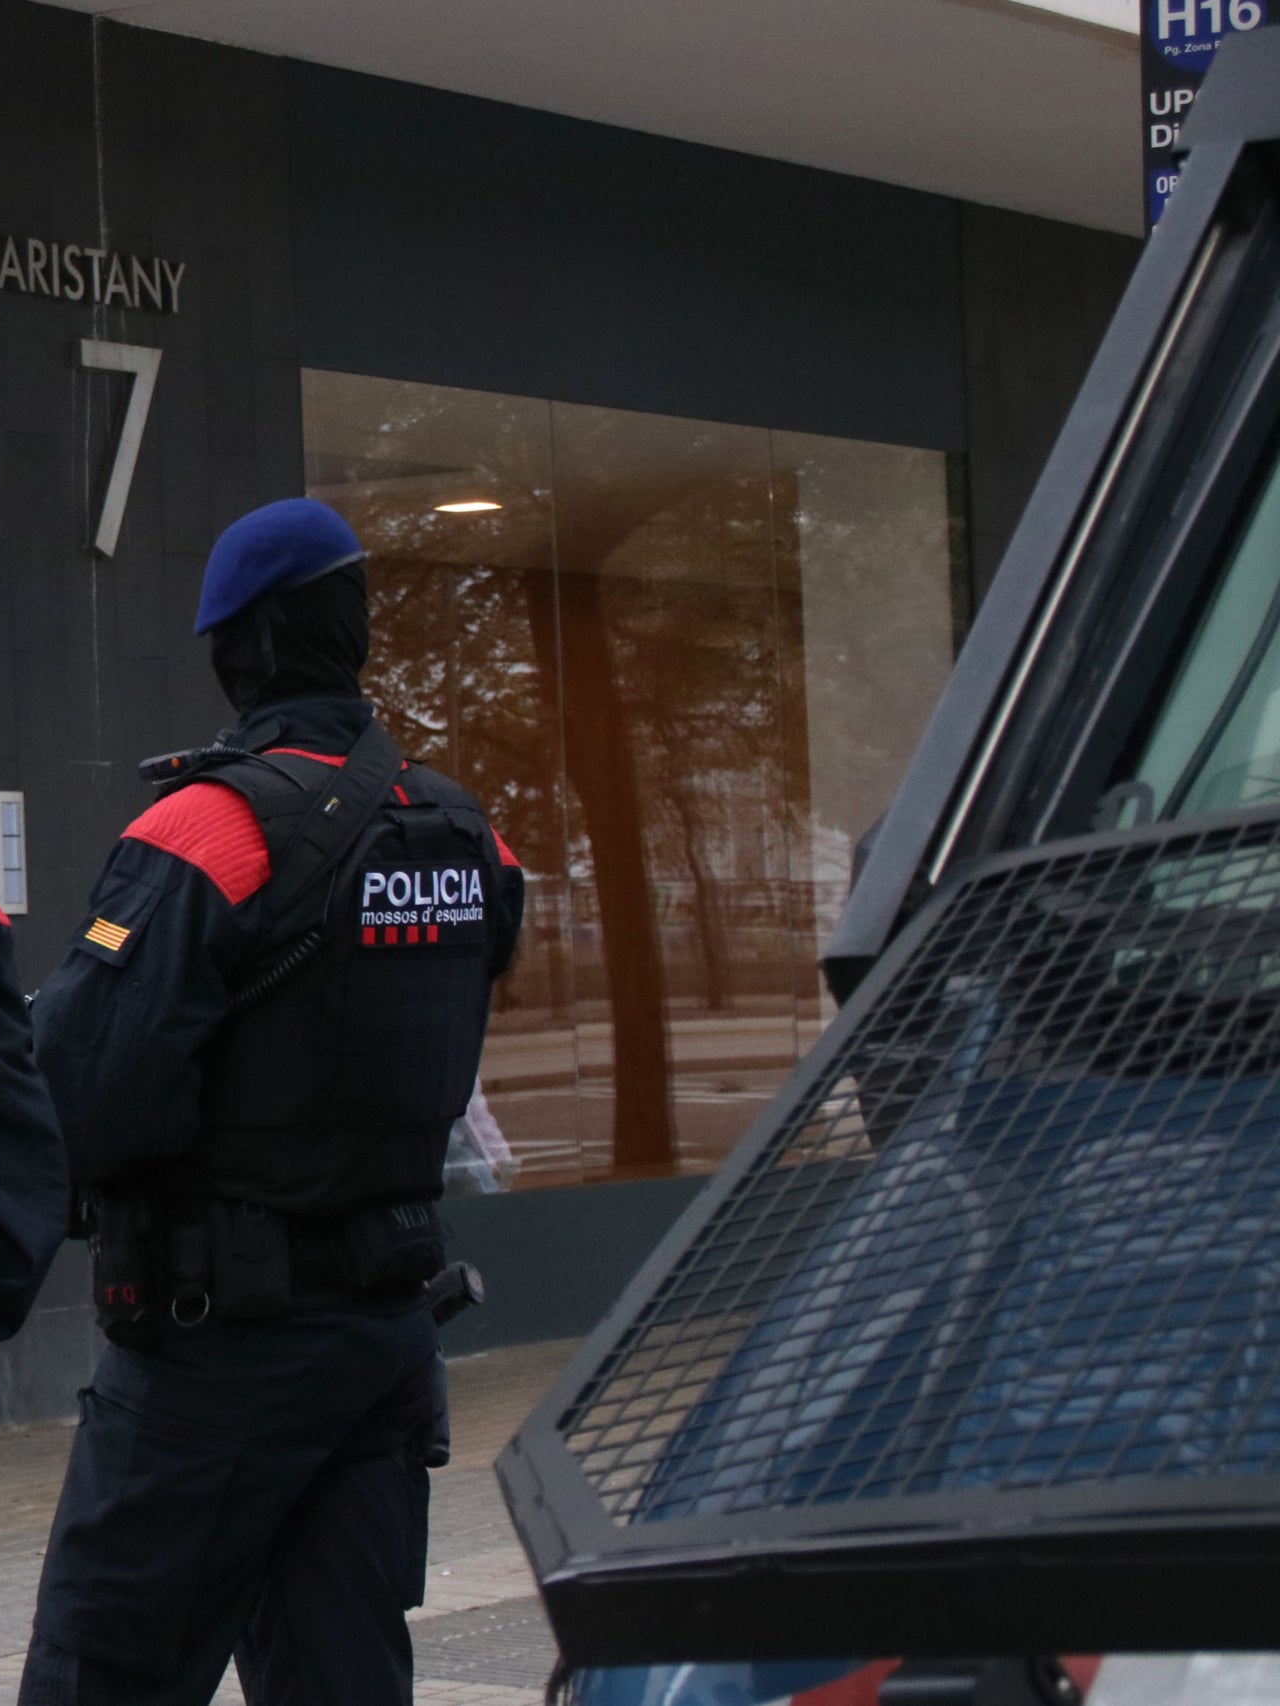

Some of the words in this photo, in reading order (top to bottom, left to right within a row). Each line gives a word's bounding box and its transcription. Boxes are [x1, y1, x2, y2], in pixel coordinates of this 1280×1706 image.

[1158, 0, 1261, 39] H16
[1164, 46, 1182, 56] Pg.
[1184, 43, 1212, 53] Zona
[1149, 89, 1201, 115] UP
[81, 338, 161, 557] 7
[360, 868, 484, 908] POLICIA
[361, 910, 418, 925] mossos
